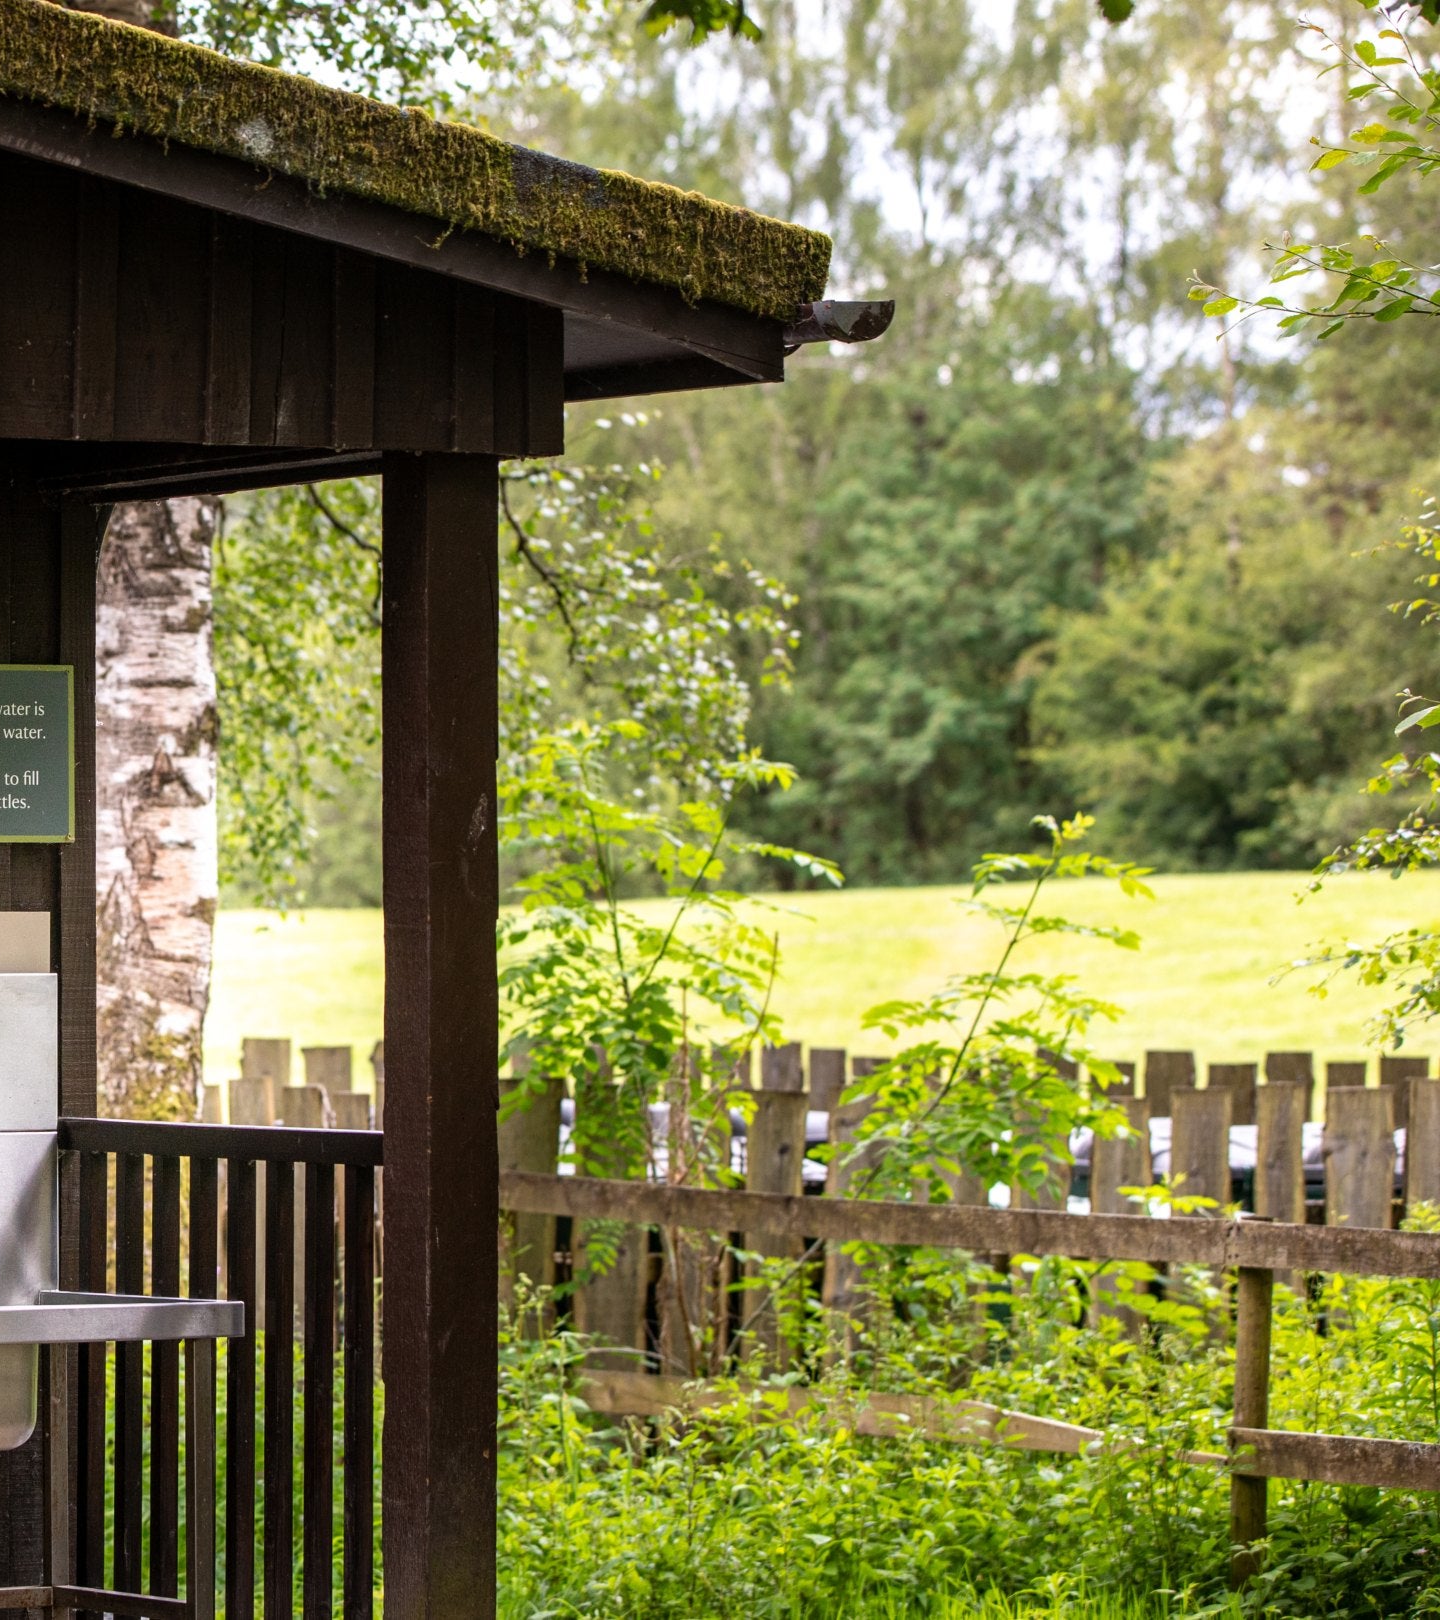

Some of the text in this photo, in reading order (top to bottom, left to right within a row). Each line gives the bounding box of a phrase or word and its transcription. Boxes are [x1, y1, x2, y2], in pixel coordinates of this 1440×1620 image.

[33, 701, 45, 716] is
[2, 726, 46, 740] water.
[4, 772, 19, 785] to
[23, 770, 39, 785] fill
